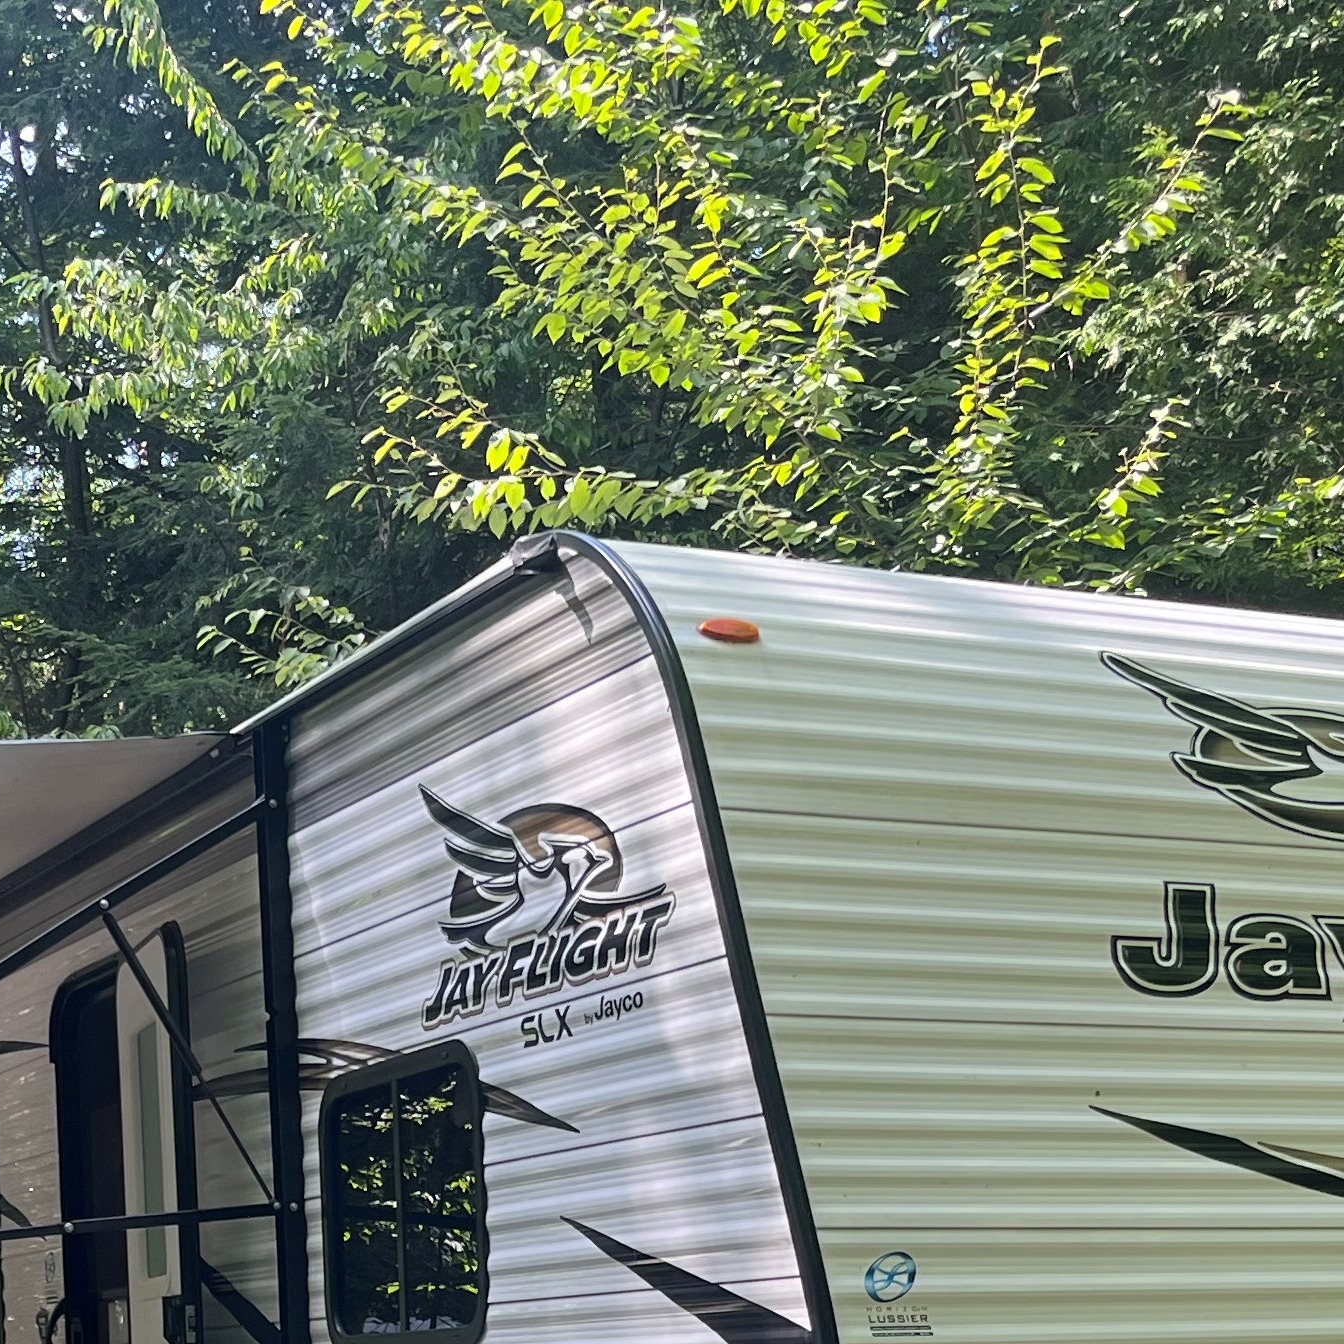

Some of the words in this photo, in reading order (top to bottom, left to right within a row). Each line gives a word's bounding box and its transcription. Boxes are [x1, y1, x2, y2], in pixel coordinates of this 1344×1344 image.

[422, 951, 506, 1031] JAY
[495, 892, 677, 1008] FLIGHT
[520, 1005, 574, 1049] SLX
[584, 1013, 594, 1025] by
[594, 991, 644, 1020] Jayco
[867, 1314, 929, 1324] LUSSIER
